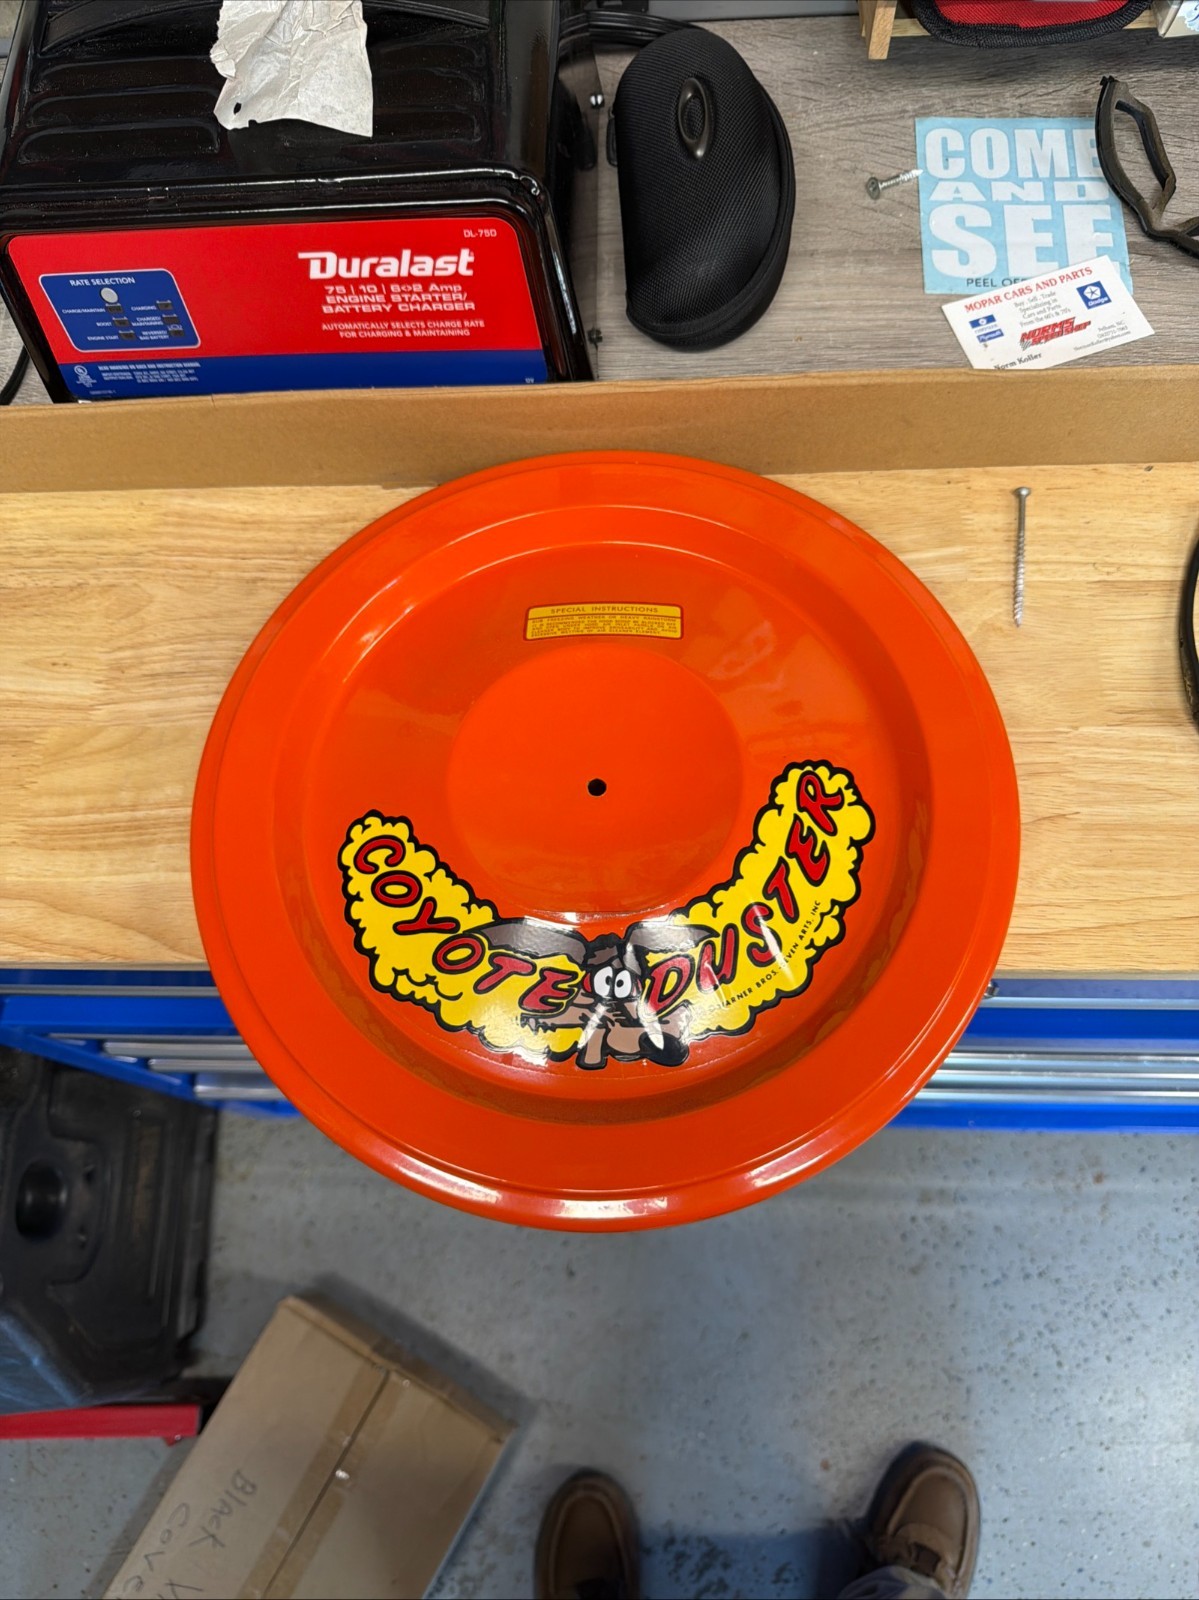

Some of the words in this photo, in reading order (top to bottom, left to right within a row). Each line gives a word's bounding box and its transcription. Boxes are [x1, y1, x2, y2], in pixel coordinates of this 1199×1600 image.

[929, 180, 1109, 202] AND
[929, 203, 1117, 278] SEE
[298, 248, 475, 280] Duralast
[69, 279, 90, 287] RATE
[91, 277, 136, 286] SELECTION
[966, 278, 997, 288] PEEL
[324, 285, 346, 295] 75
[359, 285, 377, 294] 10
[428, 284, 462, 294] Amp
[964, 295, 1002, 313] MOPAR
[1003, 285, 1033, 301] CARS
[1035, 278, 1058, 292] AND
[1058, 266, 1093, 284] PARTS
[325, 294, 387, 304] ENGINE
[390, 292, 467, 303] STARTER/
[322, 303, 392, 314] BATTERY
[398, 302, 475, 312] CHARGER
[322, 322, 389, 331] AUTOMATICALLY
[391, 321, 426, 330] SELECTS
[427, 320, 462, 329] CHARGE
[464, 320, 485, 328] RATE
[339, 331, 357, 339] FOR
[358, 330, 403, 339] CHARGING
[413, 329, 470, 338] MAINTAINING
[1016, 352, 1042, 365] Koller
[551, 605, 585, 614] SPECIAL
[591, 605, 658, 613] INSTRUCTIONS
[353, 834, 578, 1014] COYOTE
[642, 769, 845, 1018] DUSTER
[718, 987, 753, 1007] ARNER
